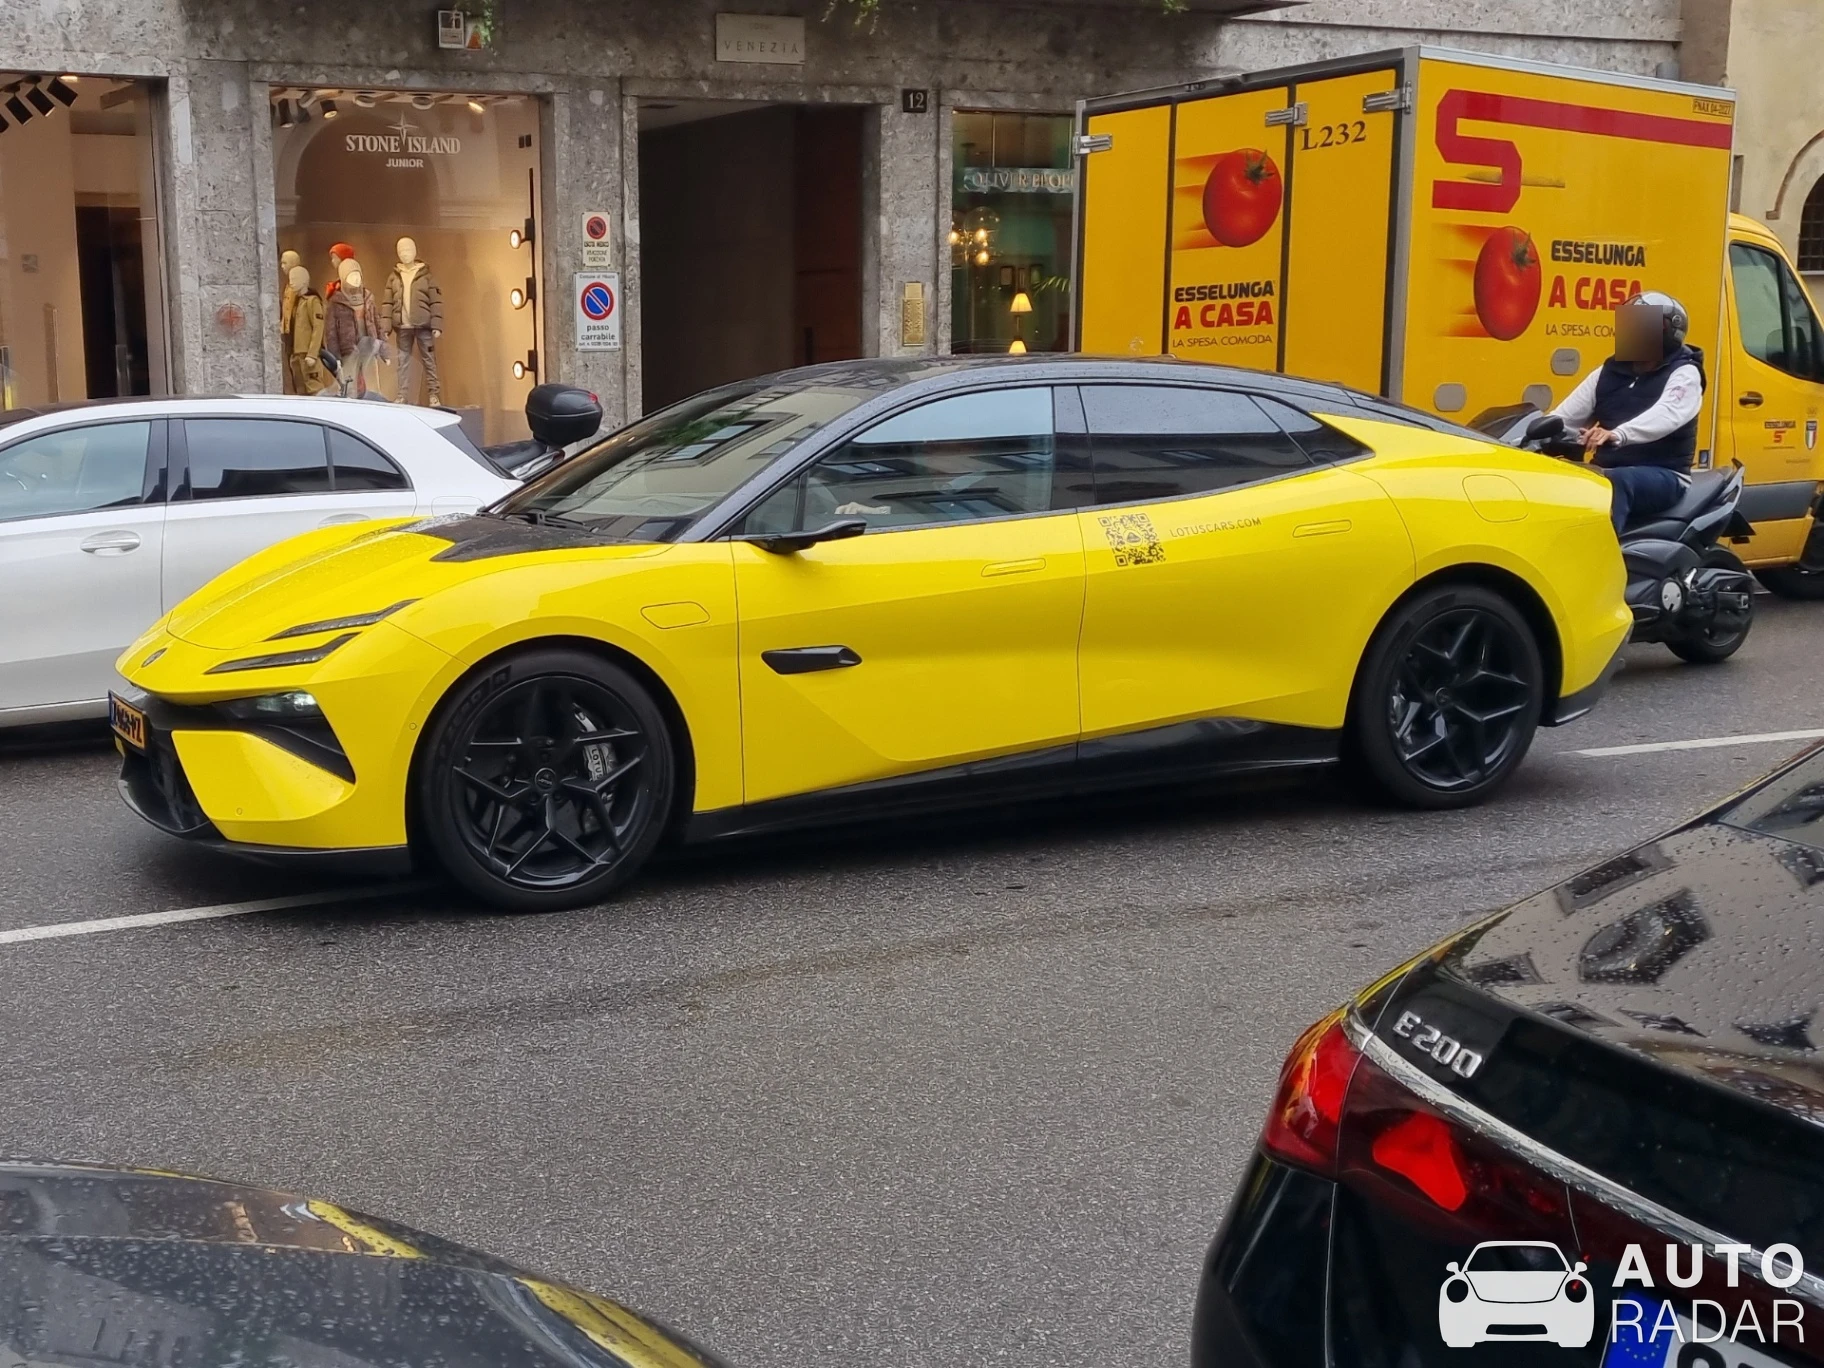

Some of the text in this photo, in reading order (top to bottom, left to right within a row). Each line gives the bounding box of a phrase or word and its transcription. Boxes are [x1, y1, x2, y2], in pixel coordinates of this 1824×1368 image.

[723, 40, 800, 55] VENEZIA
[909, 92, 924, 109] 12
[345, 134, 461, 154] STONE ISLAND
[1301, 120, 1367, 151] L232
[386, 158, 424, 168] JUNIOR
[1551, 240, 1647, 268] ESSELUNGA
[1174, 280, 1275, 303] ESSELUNGA
[1547, 274, 1567, 309] A
[1174, 300, 1274, 330] A CASA
[580, 332, 616, 340] carrabile
[586, 324, 610, 332] passo
[1545, 323, 1558, 336] LA
[1560, 324, 1591, 337] SPESA
[1172, 334, 1273, 348] LA SPESA COMODA
[1168, 517, 1263, 539] LOTUSCARS.COM
